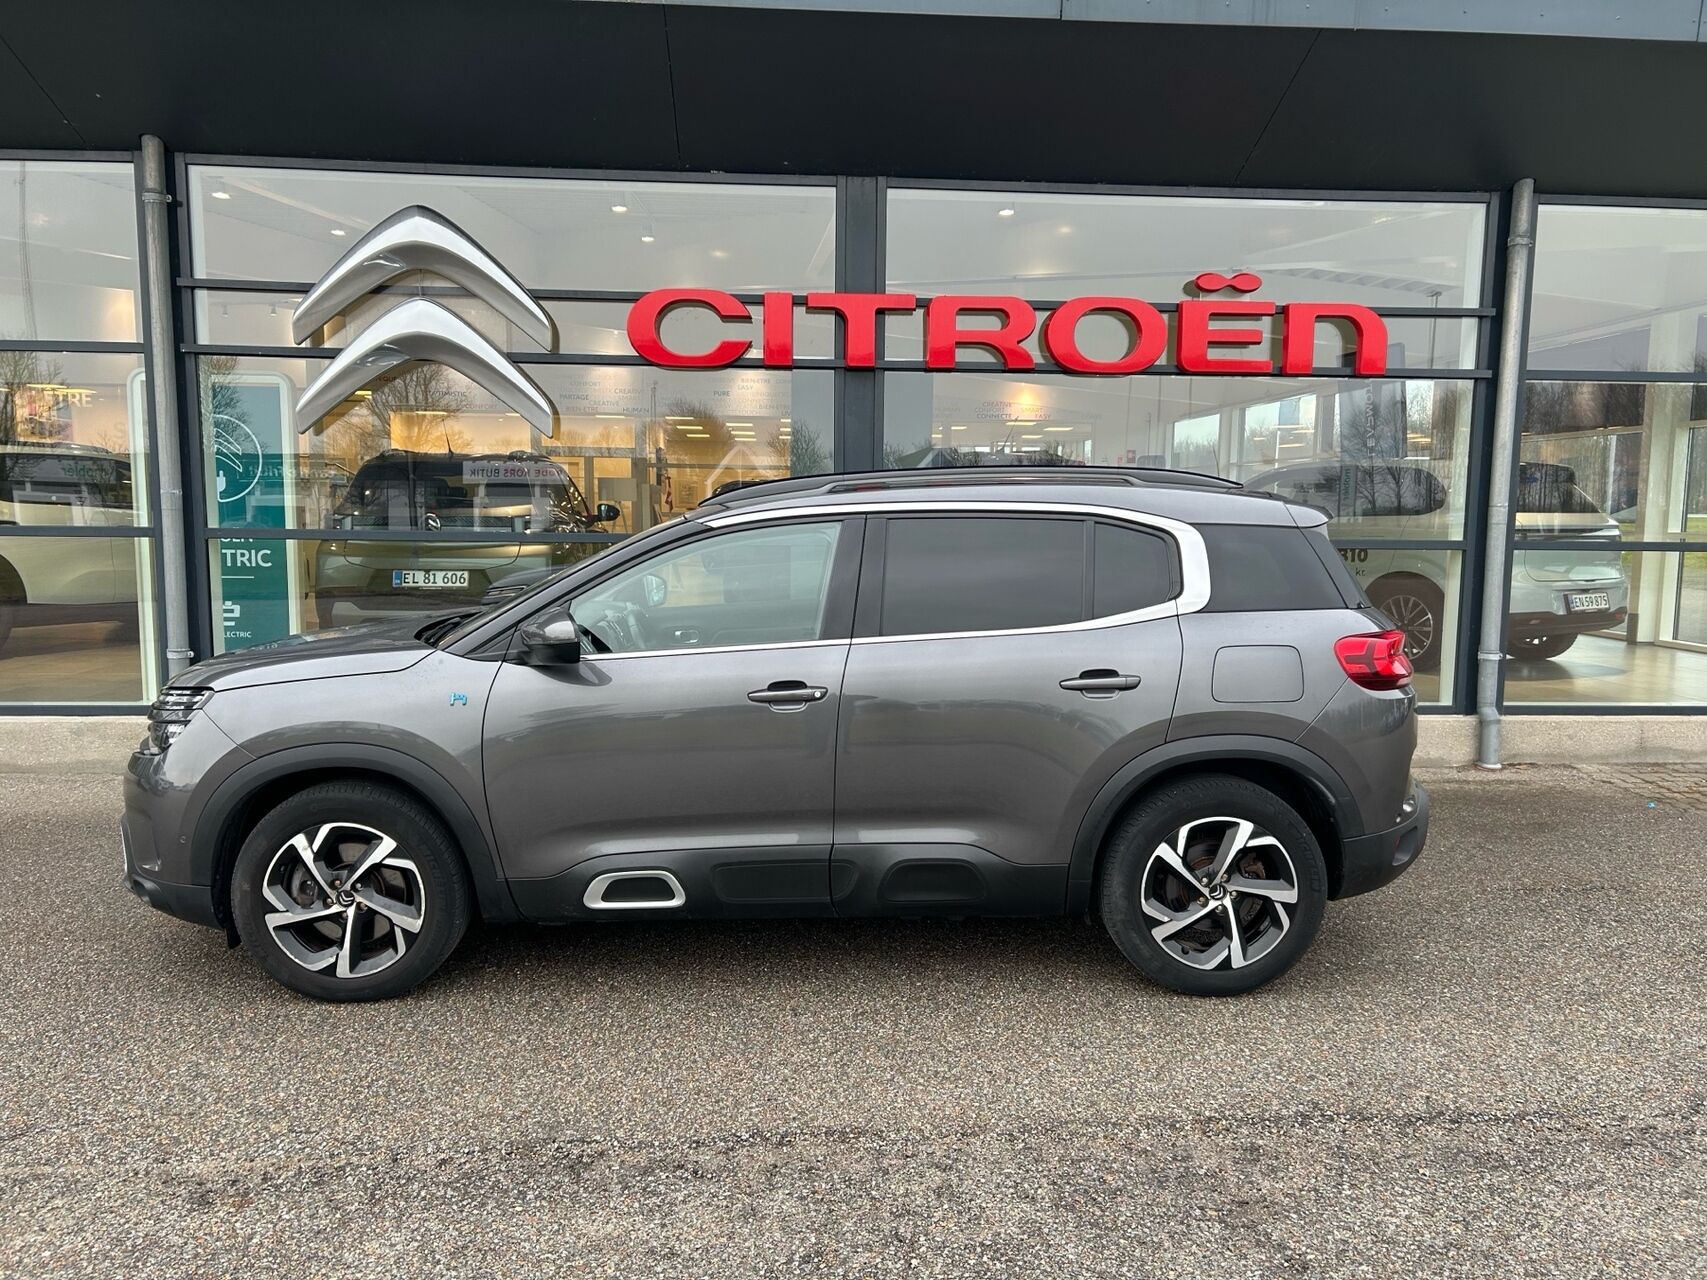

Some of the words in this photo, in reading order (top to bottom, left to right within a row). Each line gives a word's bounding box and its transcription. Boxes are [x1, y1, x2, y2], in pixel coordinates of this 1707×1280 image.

[403, 573, 419, 584] EL
[423, 572, 437, 584] 81
[442, 572, 466, 584] 606
